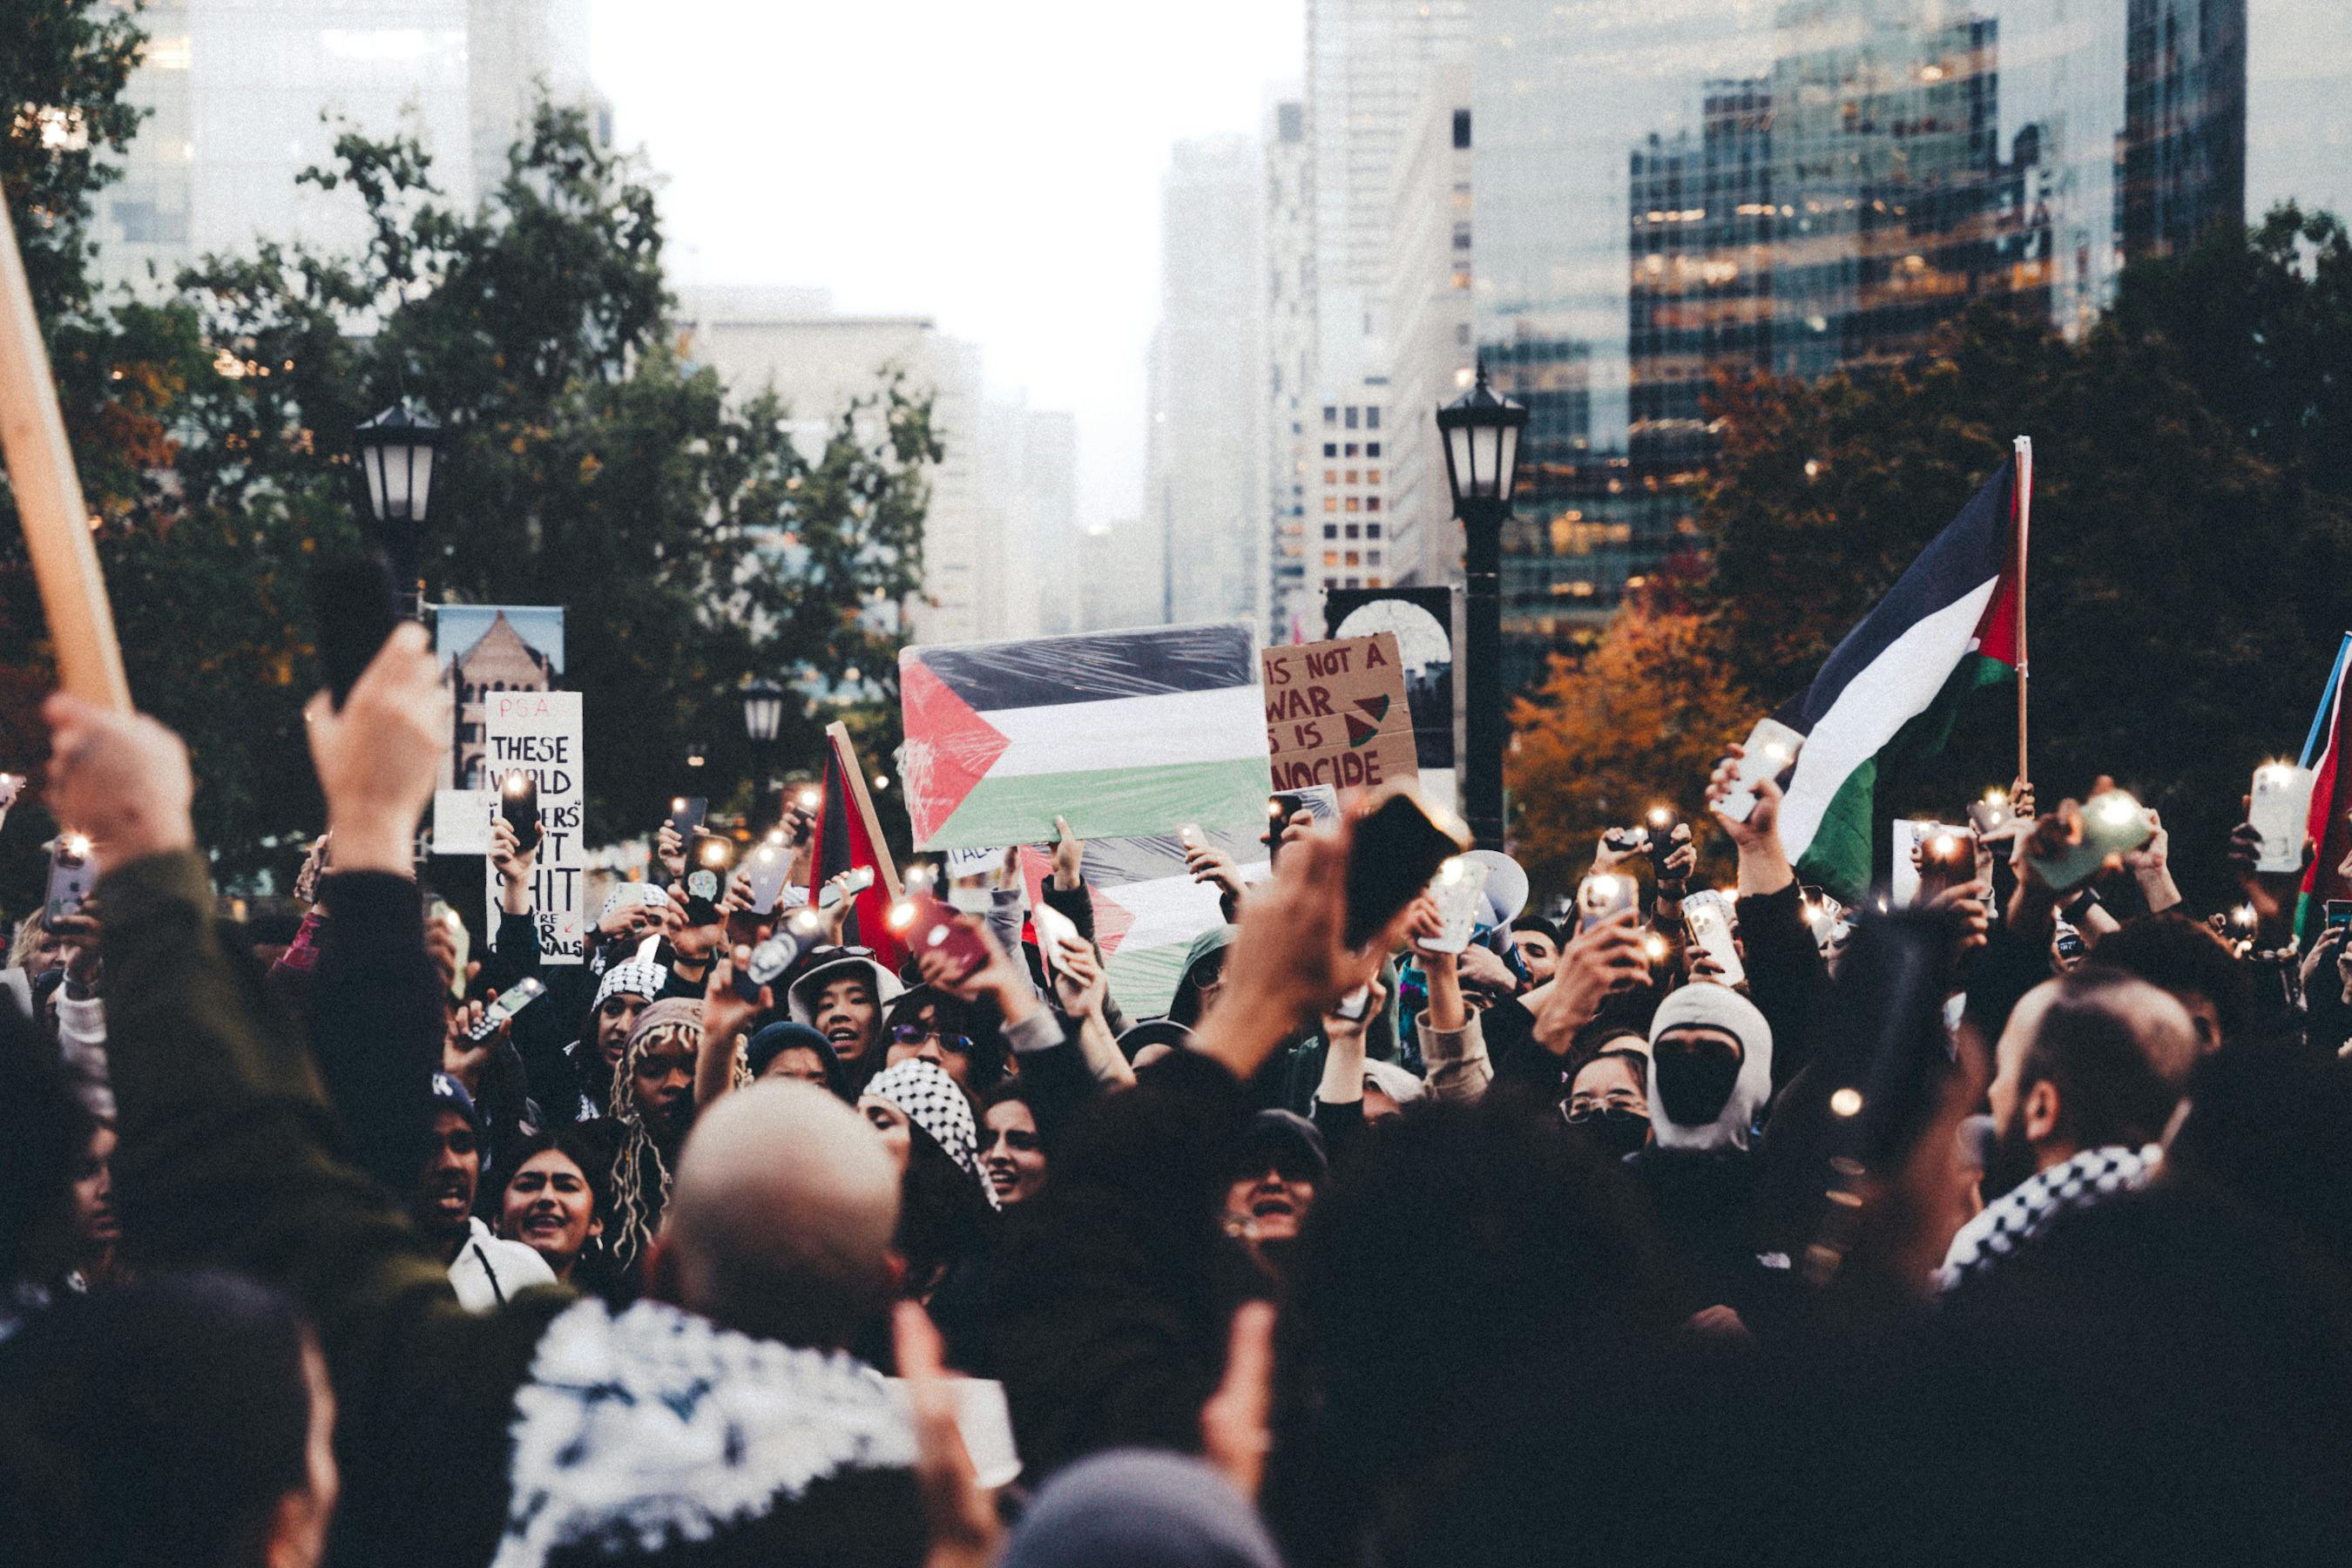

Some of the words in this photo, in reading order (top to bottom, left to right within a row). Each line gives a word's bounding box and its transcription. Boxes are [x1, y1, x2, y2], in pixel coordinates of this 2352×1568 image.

[1266, 658, 1291, 685] IS
[1306, 647, 1351, 679] NOT
[1367, 643, 1388, 669] A
[500, 698, 551, 718] PSA
[1266, 686, 1335, 722] WAR
[490, 736, 569, 764] THESE
[1294, 721, 1323, 749] IS
[1271, 751, 1382, 791] NOCIDE
